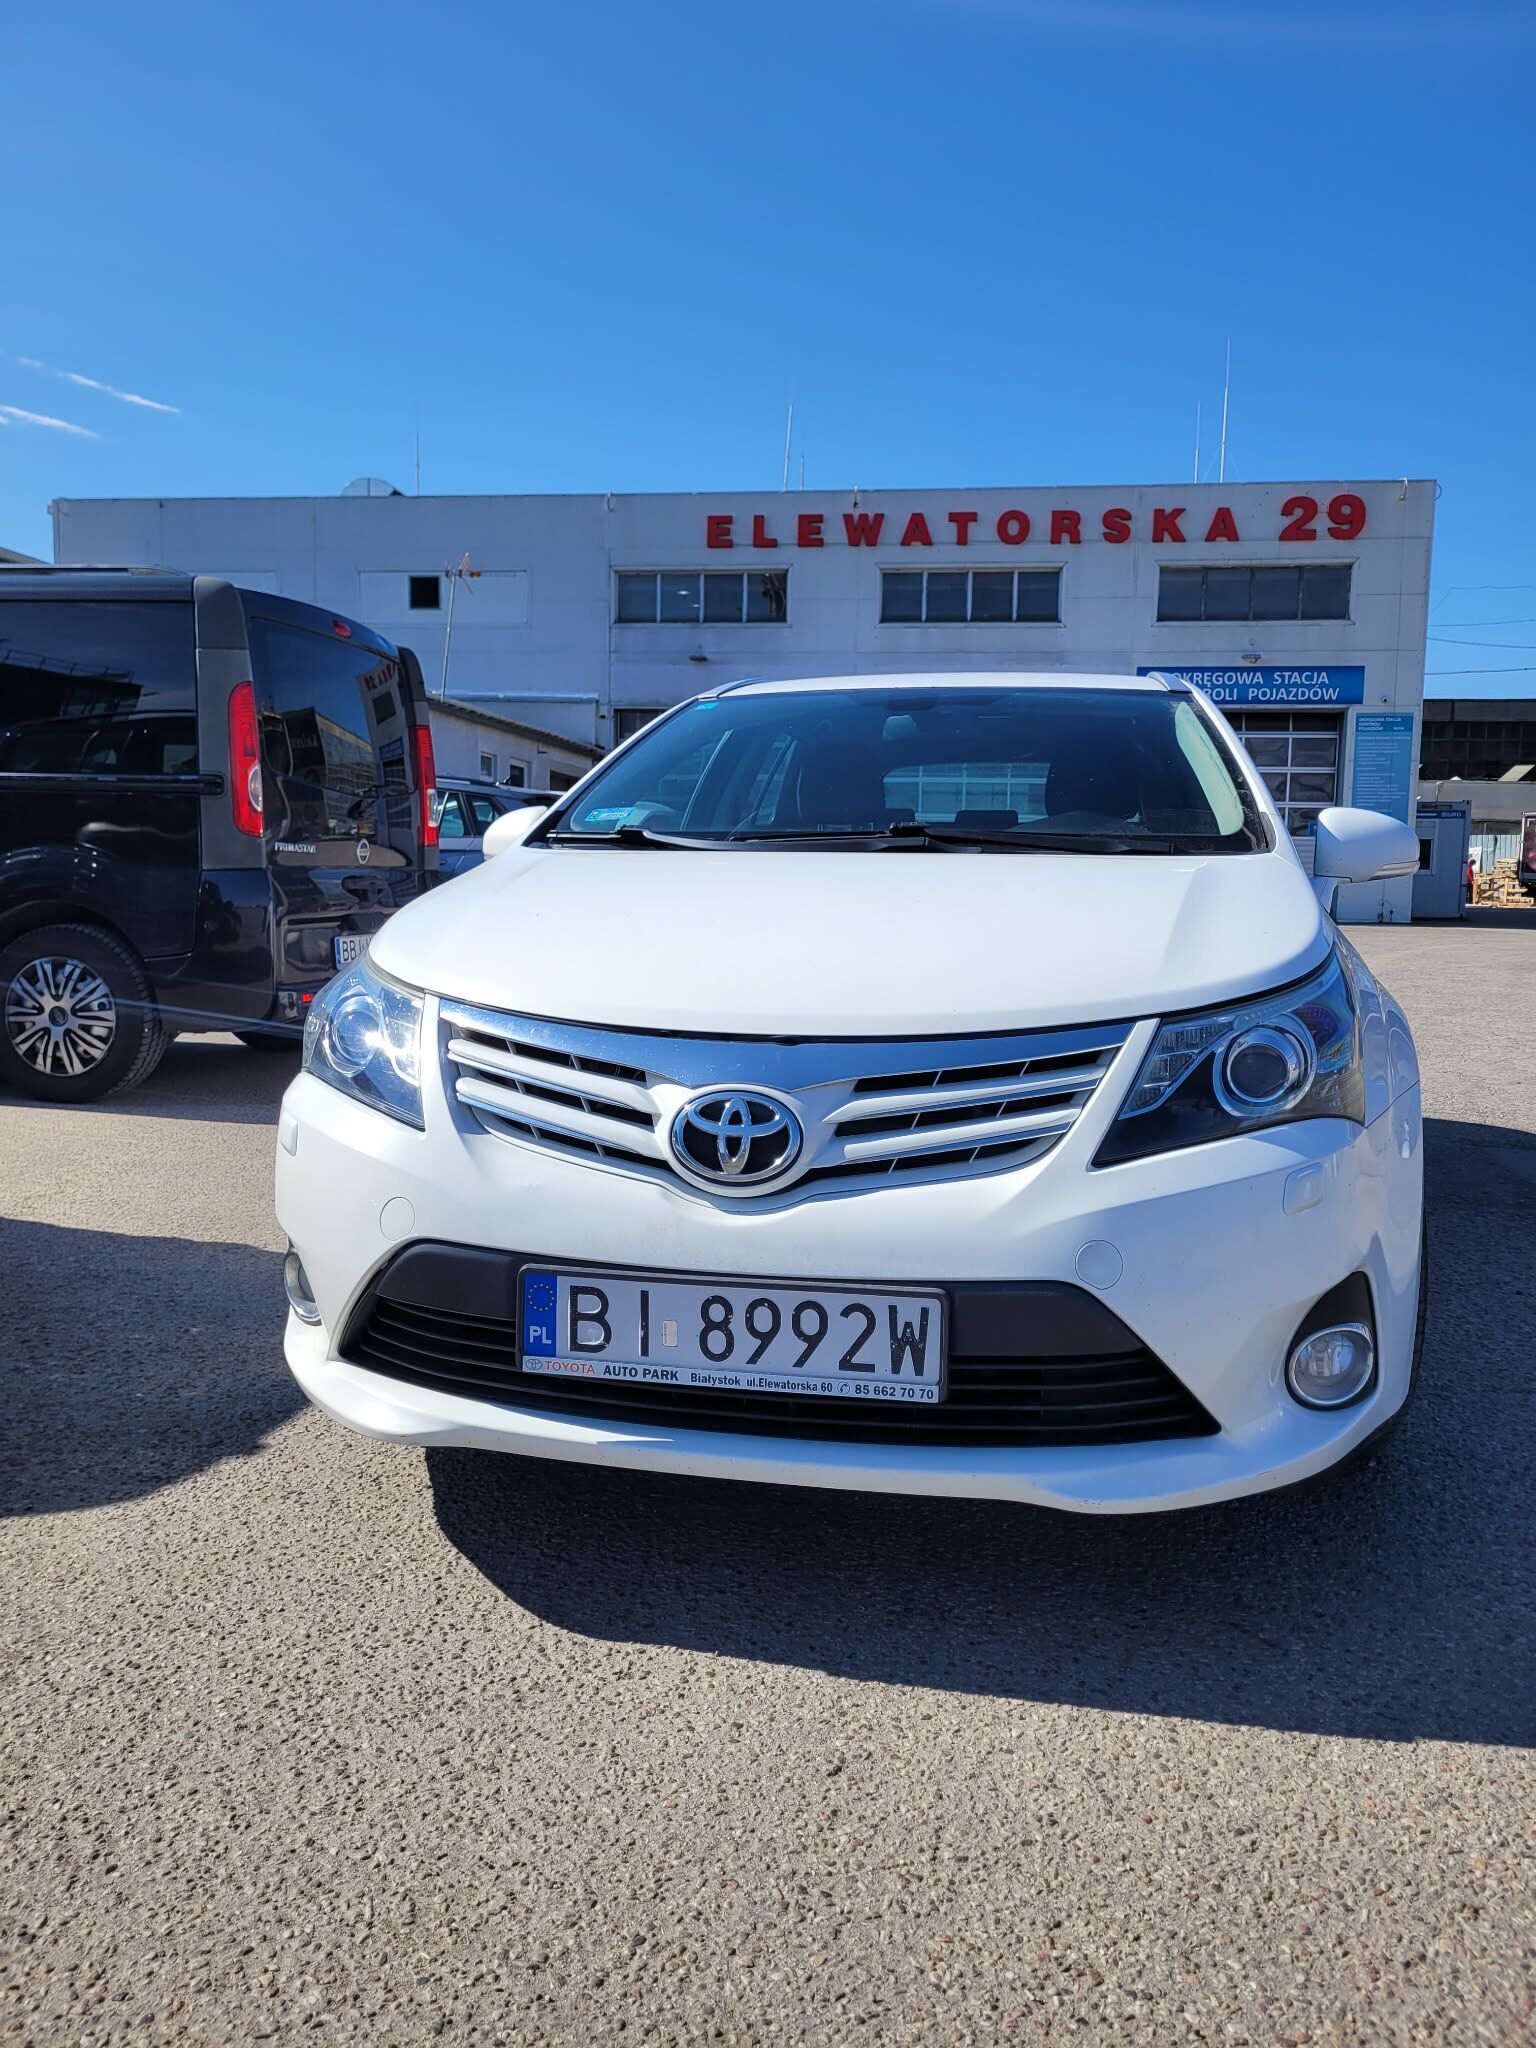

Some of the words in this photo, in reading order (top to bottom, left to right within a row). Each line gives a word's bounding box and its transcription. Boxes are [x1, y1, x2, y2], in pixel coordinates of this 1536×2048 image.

[706, 506, 1240, 548] ELEWATORSKA
[1278, 494, 1368, 541] 29
[1273, 671, 1329, 685] STACJA
[1248, 686, 1340, 701] POJAZDÓW
[274, 841, 317, 854] PRIMASTAR
[529, 1325, 552, 1345] PL
[568, 1285, 650, 1357] BI
[699, 1295, 931, 1377] 8992W
[544, 1360, 596, 1375] TOYOTA
[603, 1365, 639, 1378] AUTO
[642, 1368, 680, 1382] PARK
[690, 1372, 741, 1387] Białystok
[746, 1377, 818, 1393] ul.Elewatorska
[820, 1382, 833, 1393] 60
[854, 1384, 870, 1396] 85
[873, 1385, 896, 1397] 662
[900, 1387, 915, 1399] 70
[918, 1388, 934, 1400] 70
